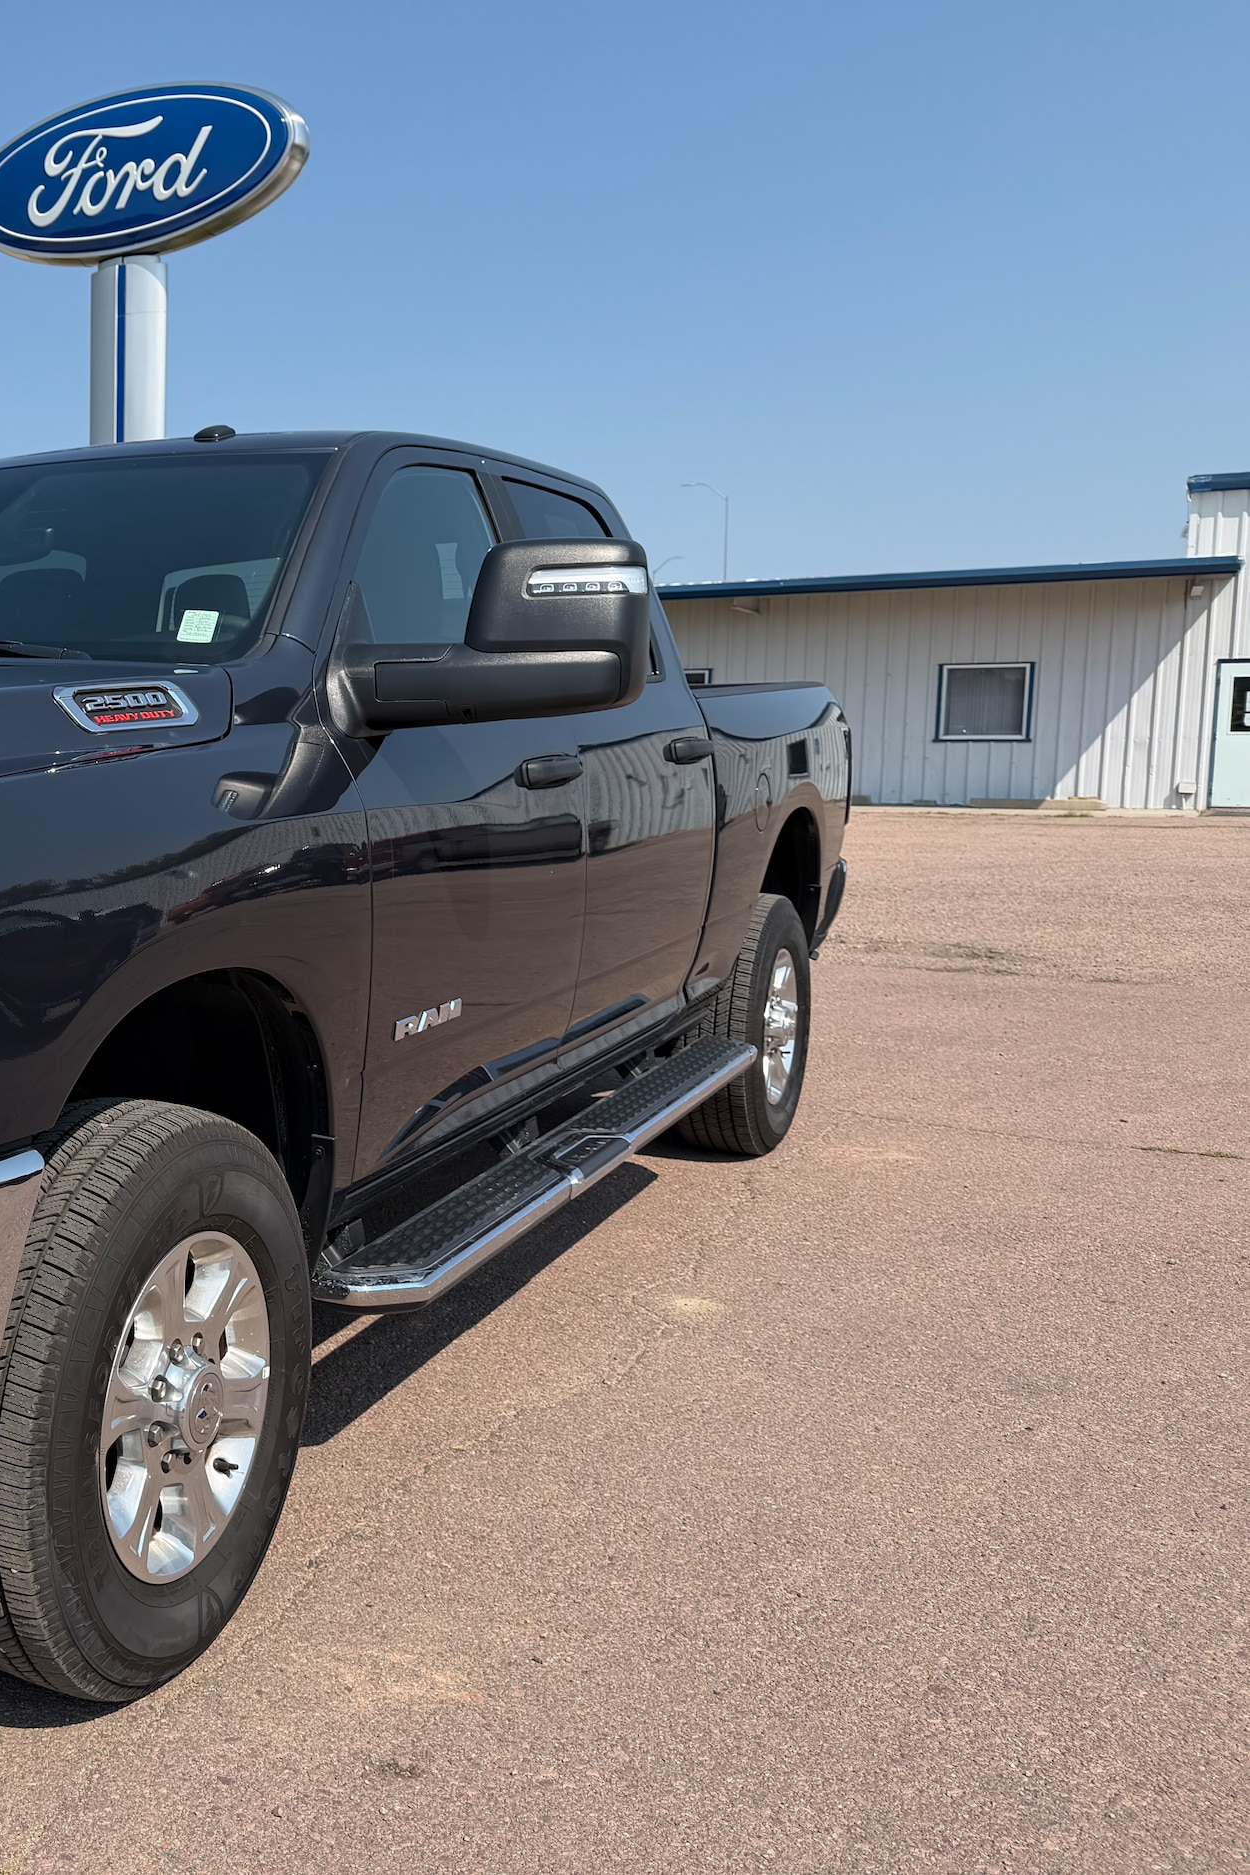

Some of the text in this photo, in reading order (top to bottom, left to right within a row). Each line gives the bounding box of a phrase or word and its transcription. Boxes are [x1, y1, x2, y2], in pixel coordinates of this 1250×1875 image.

[27, 115, 213, 227] Ford
[81, 691, 168, 713] 2500
[94, 709, 176, 724] HEAVY DUTY
[393, 997, 463, 1042] RAM
